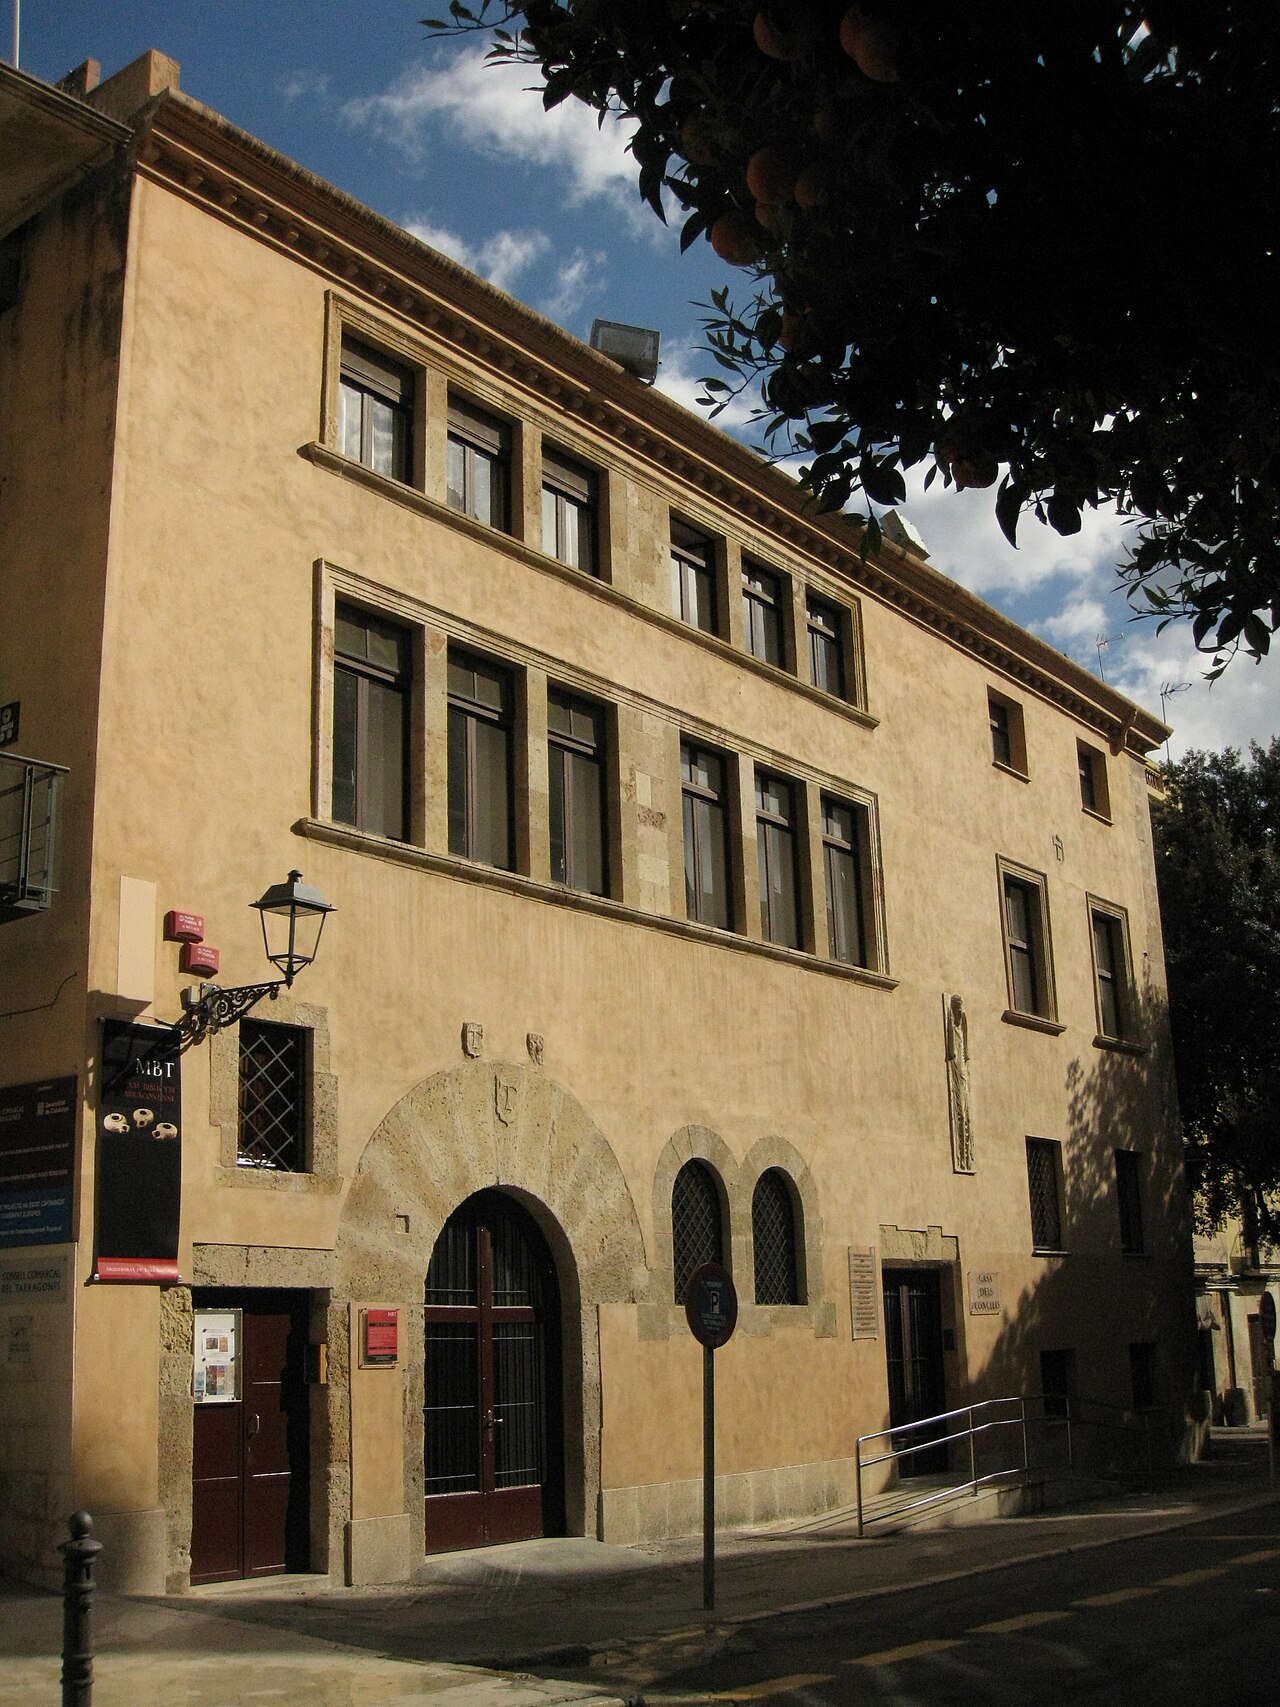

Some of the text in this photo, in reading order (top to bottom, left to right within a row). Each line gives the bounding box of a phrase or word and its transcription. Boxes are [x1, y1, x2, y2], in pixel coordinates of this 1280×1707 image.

[136, 1058, 175, 1078] MBT
[27, 1268, 61, 1279] COMARCAL
[978, 1274, 993, 1283] CASA
